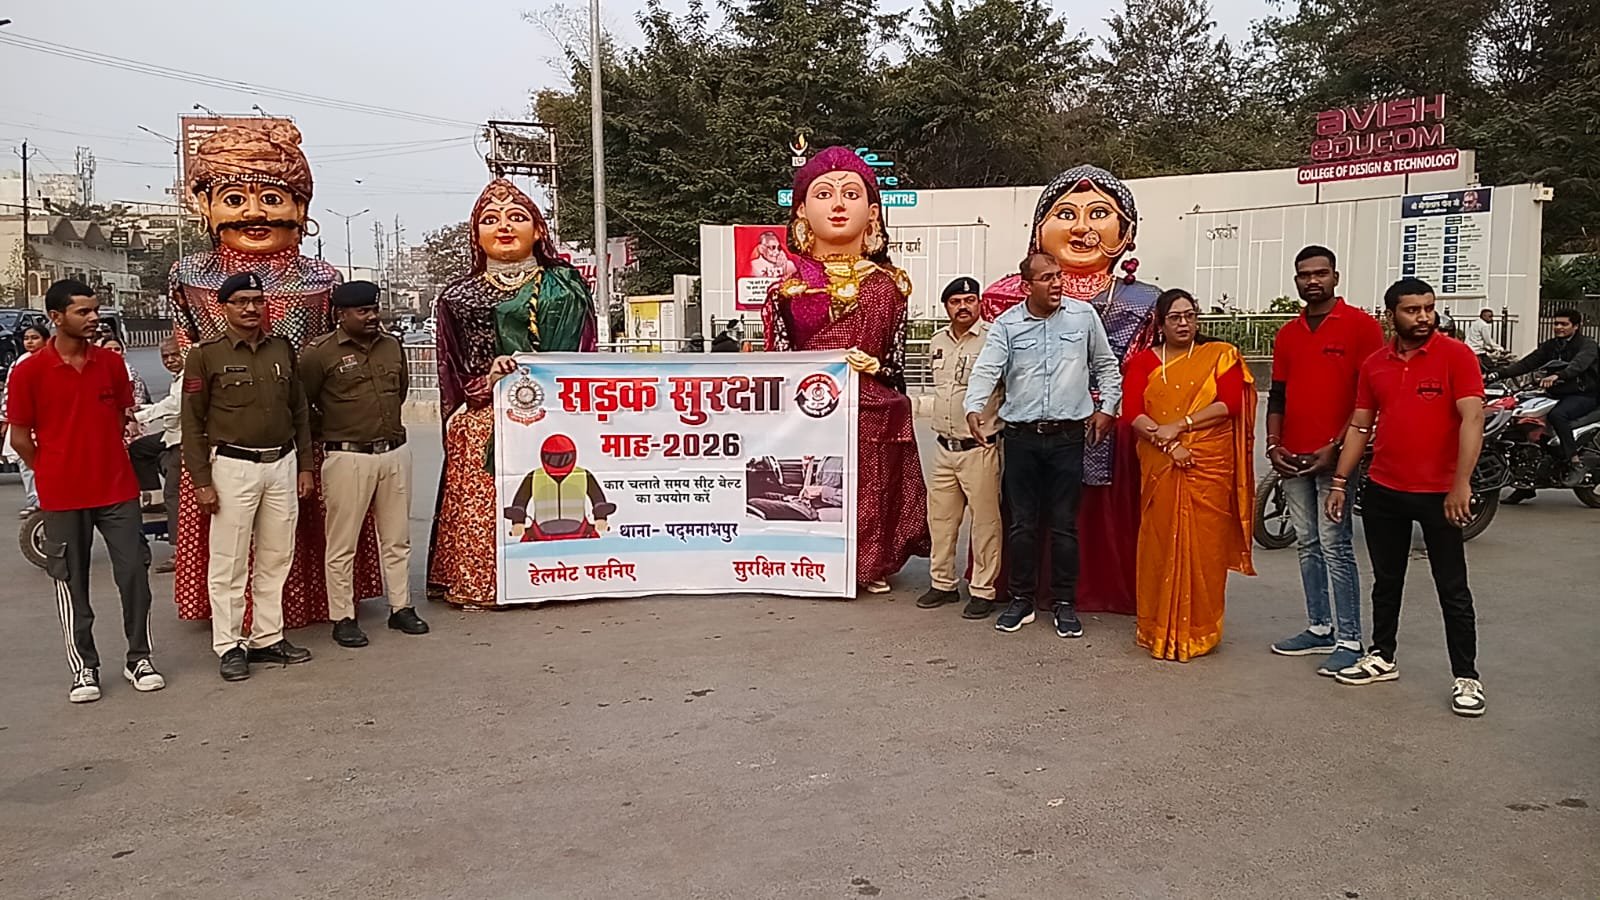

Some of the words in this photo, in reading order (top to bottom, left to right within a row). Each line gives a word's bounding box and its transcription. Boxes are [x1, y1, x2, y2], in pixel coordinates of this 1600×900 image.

[1299, 165, 1335, 181] COLLEGE
[1336, 164, 1348, 177] OF
[1350, 161, 1382, 176] DESIGN
[1383, 160, 1393, 172] &
[1393, 152, 1458, 171] TECHNOLOGY
[880, 194, 916, 205] ENTRE
[556, 377, 659, 422] सड़क
[668, 375, 785, 426] सुरक्षा
[600, 433, 740, 457] माह-2026
[603, 479, 624, 490] कार
[627, 475, 660, 490] चलाते
[664, 478, 690, 490] समय
[693, 475, 715, 489] सीट
[635, 493, 651, 504] का
[655, 489, 690, 504] उपयोग
[693, 489, 711, 504] करें
[619, 523, 660, 538] थाना-
[665, 522, 739, 543] पद्मनाभपुर
[528, 561, 579, 586] हेलमेट
[584, 558, 637, 581] पहनिए
[732, 555, 786, 582] सुरक्षित
[790, 556, 826, 582] रहिए
